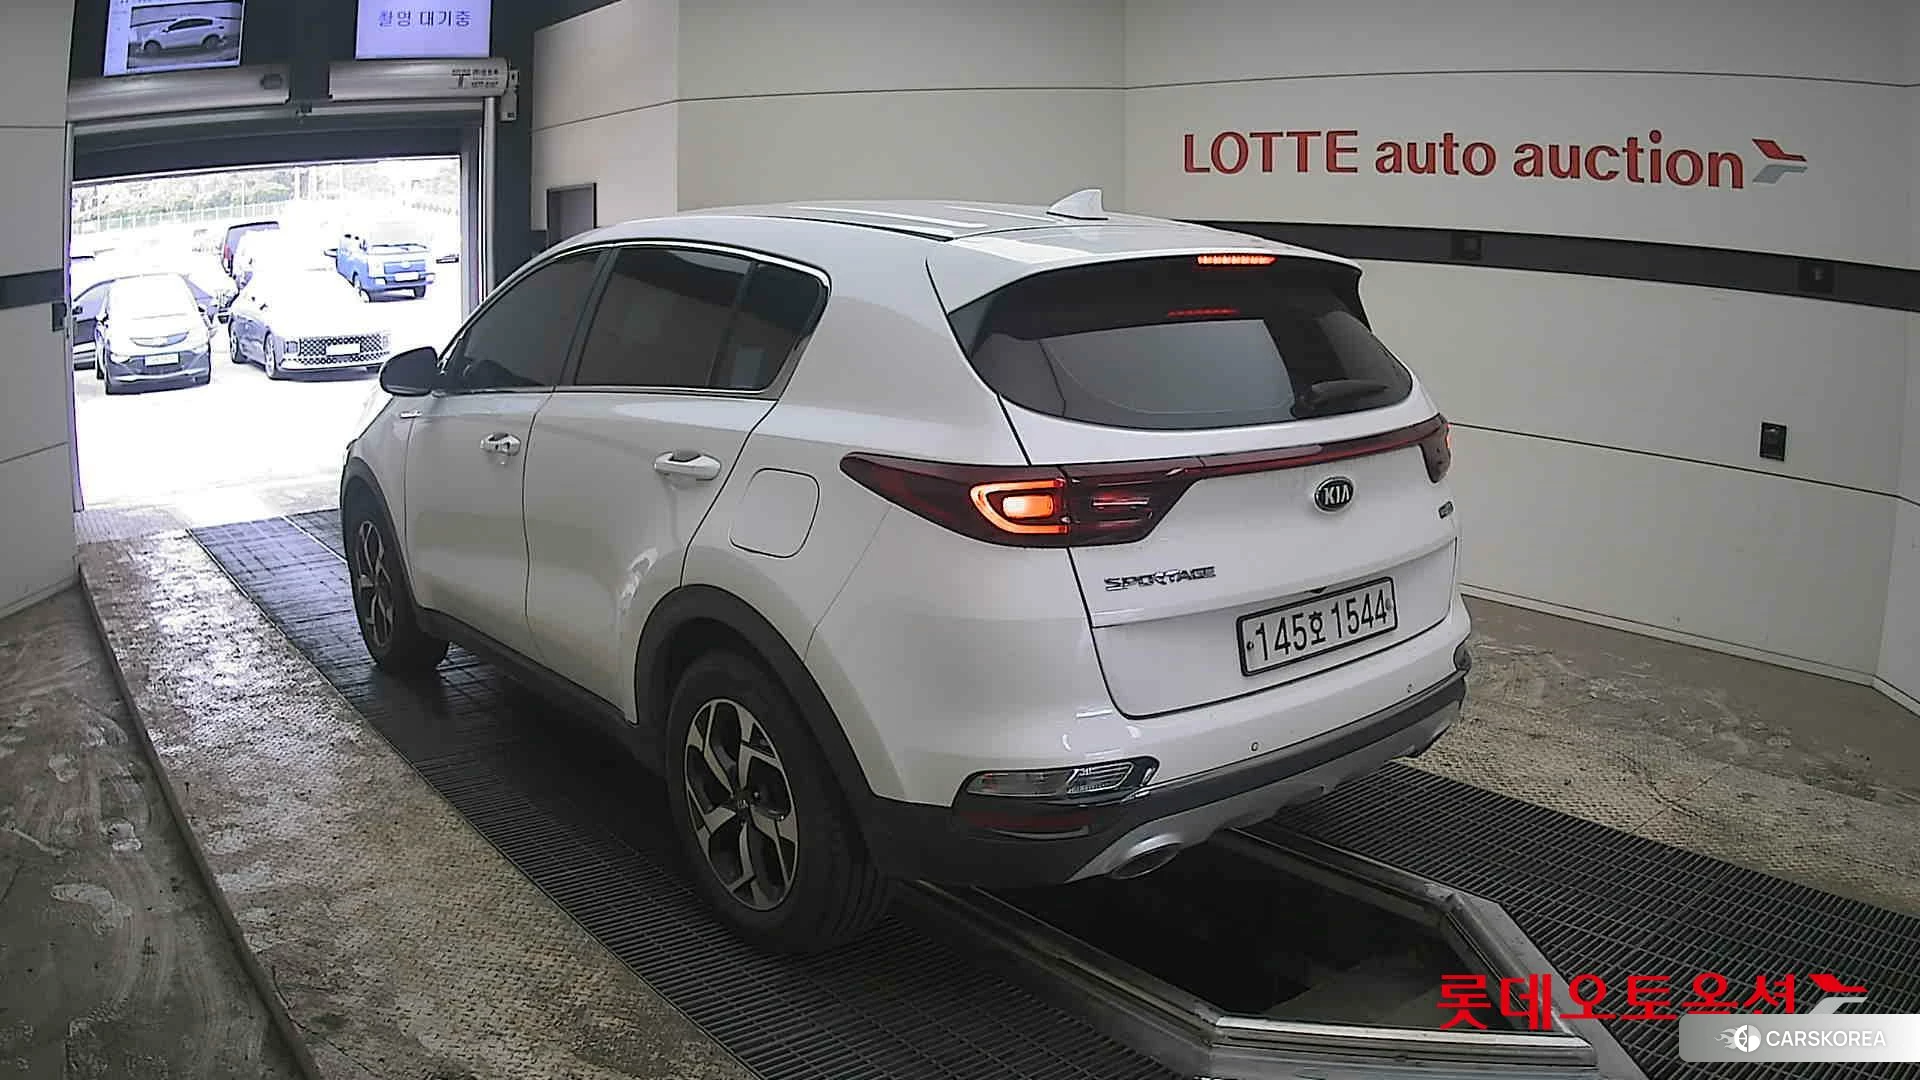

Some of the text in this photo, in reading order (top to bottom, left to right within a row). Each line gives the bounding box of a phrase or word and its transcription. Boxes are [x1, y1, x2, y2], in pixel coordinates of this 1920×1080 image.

[419, 10, 472, 28] 대기중
[1184, 130, 1744, 189] LOTTE auto auction
[1255, 588, 1388, 661] 145호 1544
